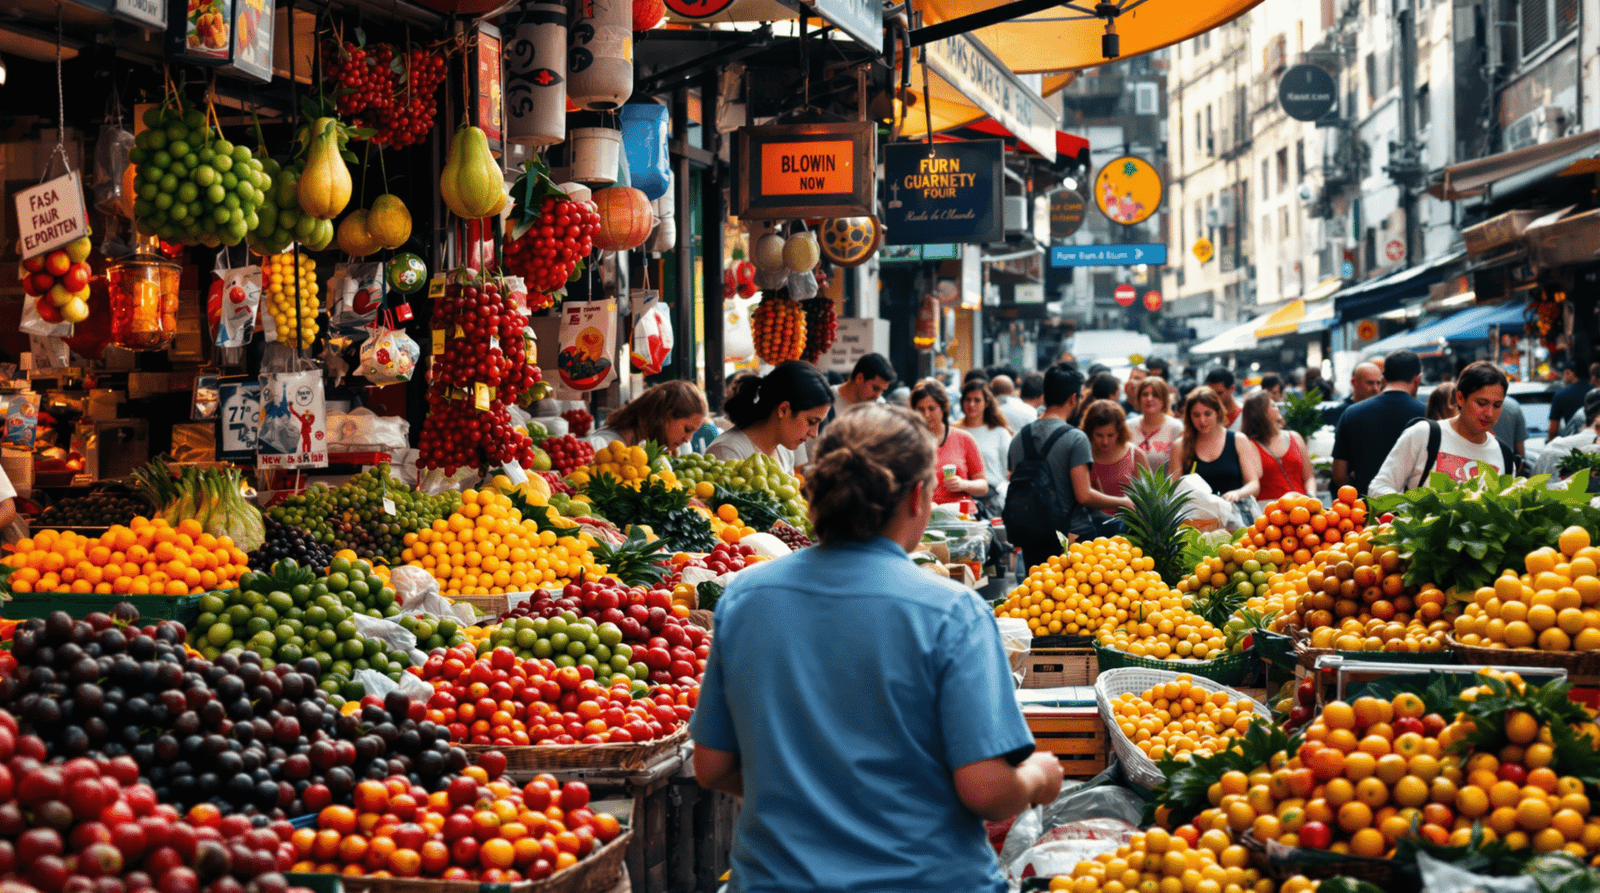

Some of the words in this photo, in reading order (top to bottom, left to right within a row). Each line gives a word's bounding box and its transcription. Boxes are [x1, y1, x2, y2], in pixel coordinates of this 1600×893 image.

[781, 154, 836, 174] BLOWIN
[920, 158, 960, 174] FURN
[800, 177, 826, 191] NOW
[904, 172, 977, 190] GUARNETY
[29, 188, 60, 212] FASA
[32, 207, 60, 231] FAUR
